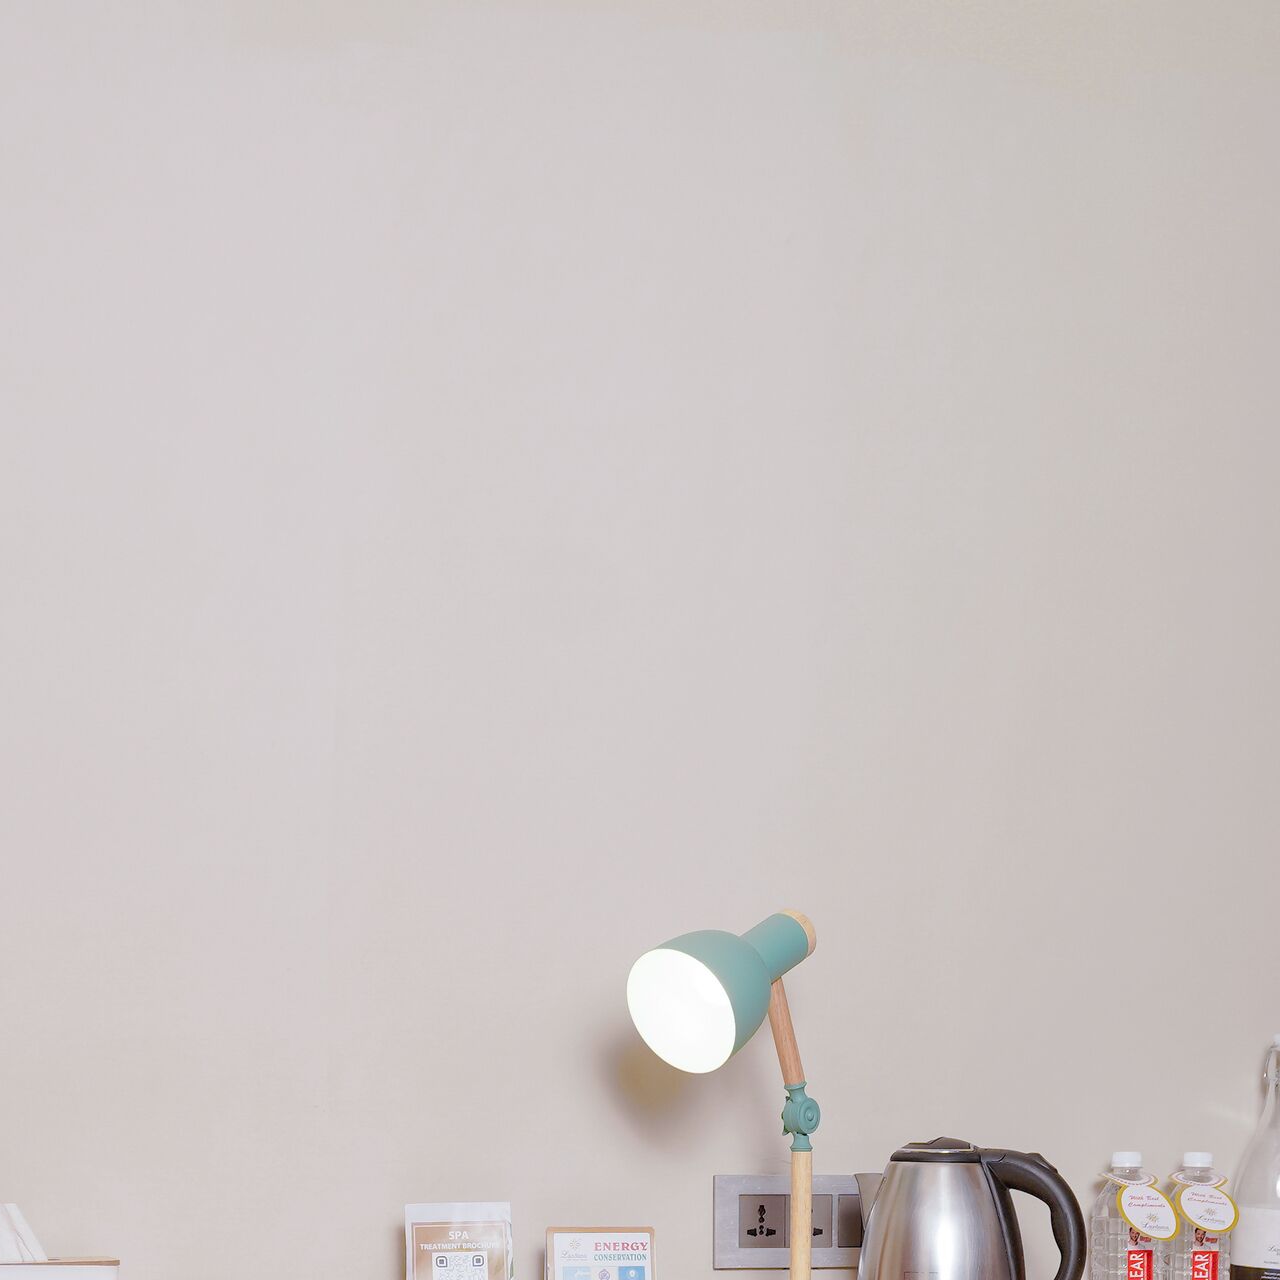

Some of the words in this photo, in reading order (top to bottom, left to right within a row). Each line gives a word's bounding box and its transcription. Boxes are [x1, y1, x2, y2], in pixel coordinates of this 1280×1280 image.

[448, 1231, 470, 1240] SPA
[420, 1242, 462, 1250] TREATMENT
[594, 1242, 648, 1251] ENERGY
[593, 1253, 647, 1261] CONSERVATION
